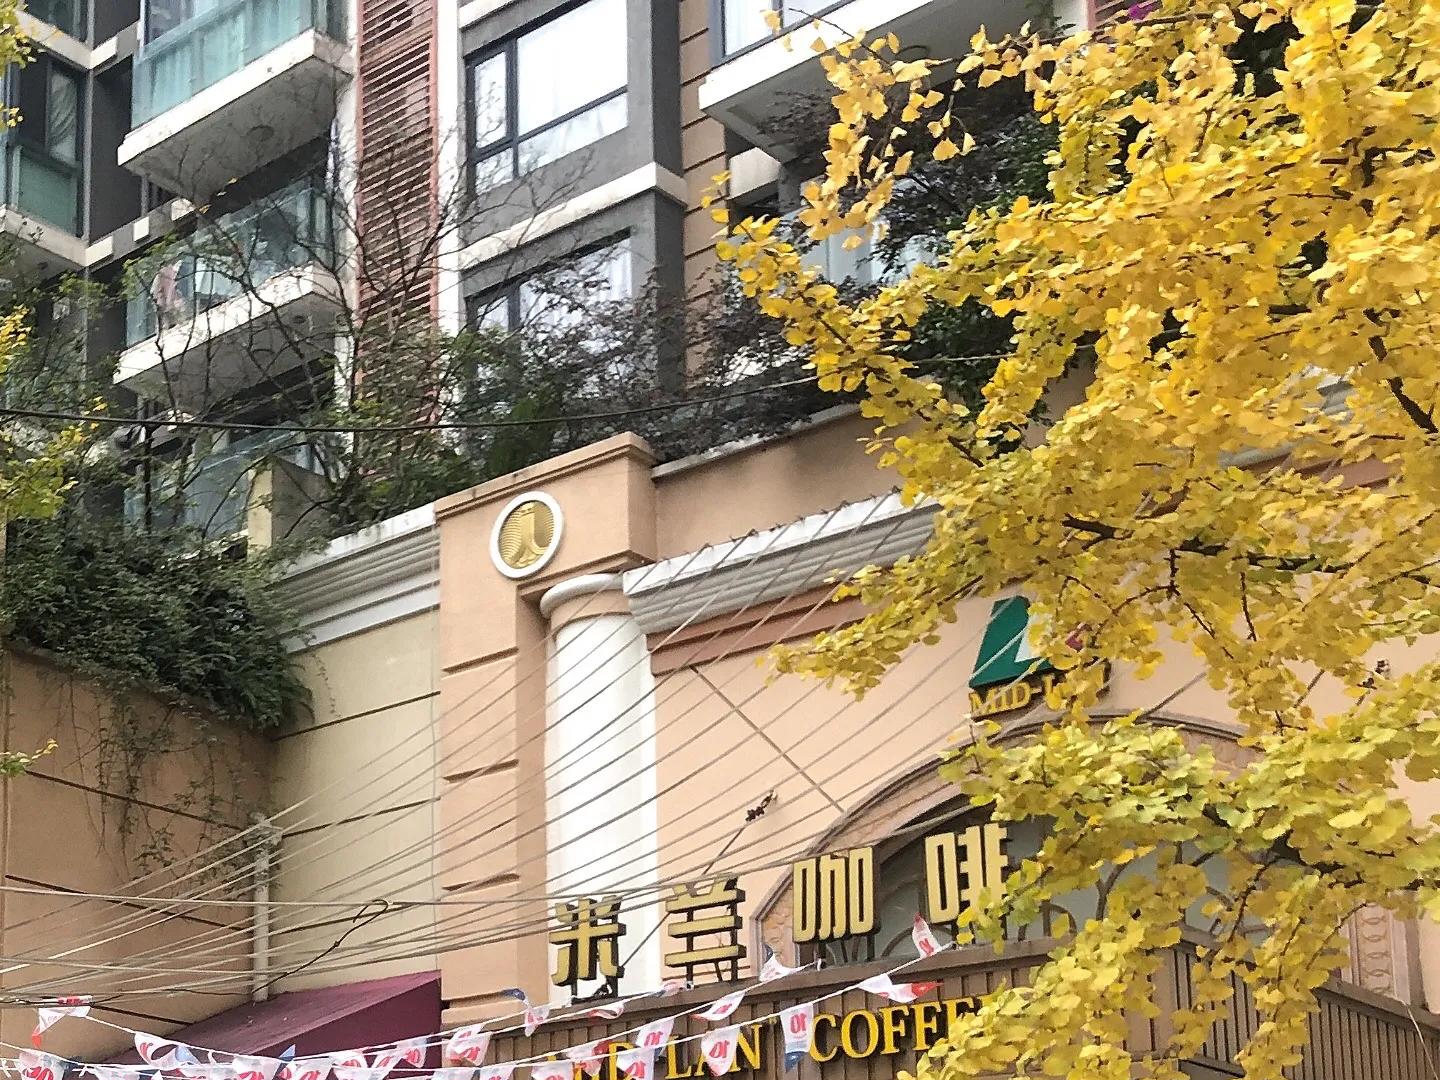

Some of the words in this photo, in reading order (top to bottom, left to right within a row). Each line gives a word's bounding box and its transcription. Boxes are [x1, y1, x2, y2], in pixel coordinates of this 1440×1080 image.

[548, 823, 1008, 985] 米兰咖啡
[665, 1025, 763, 1079] LN
[807, 994, 993, 1063] COFFE
